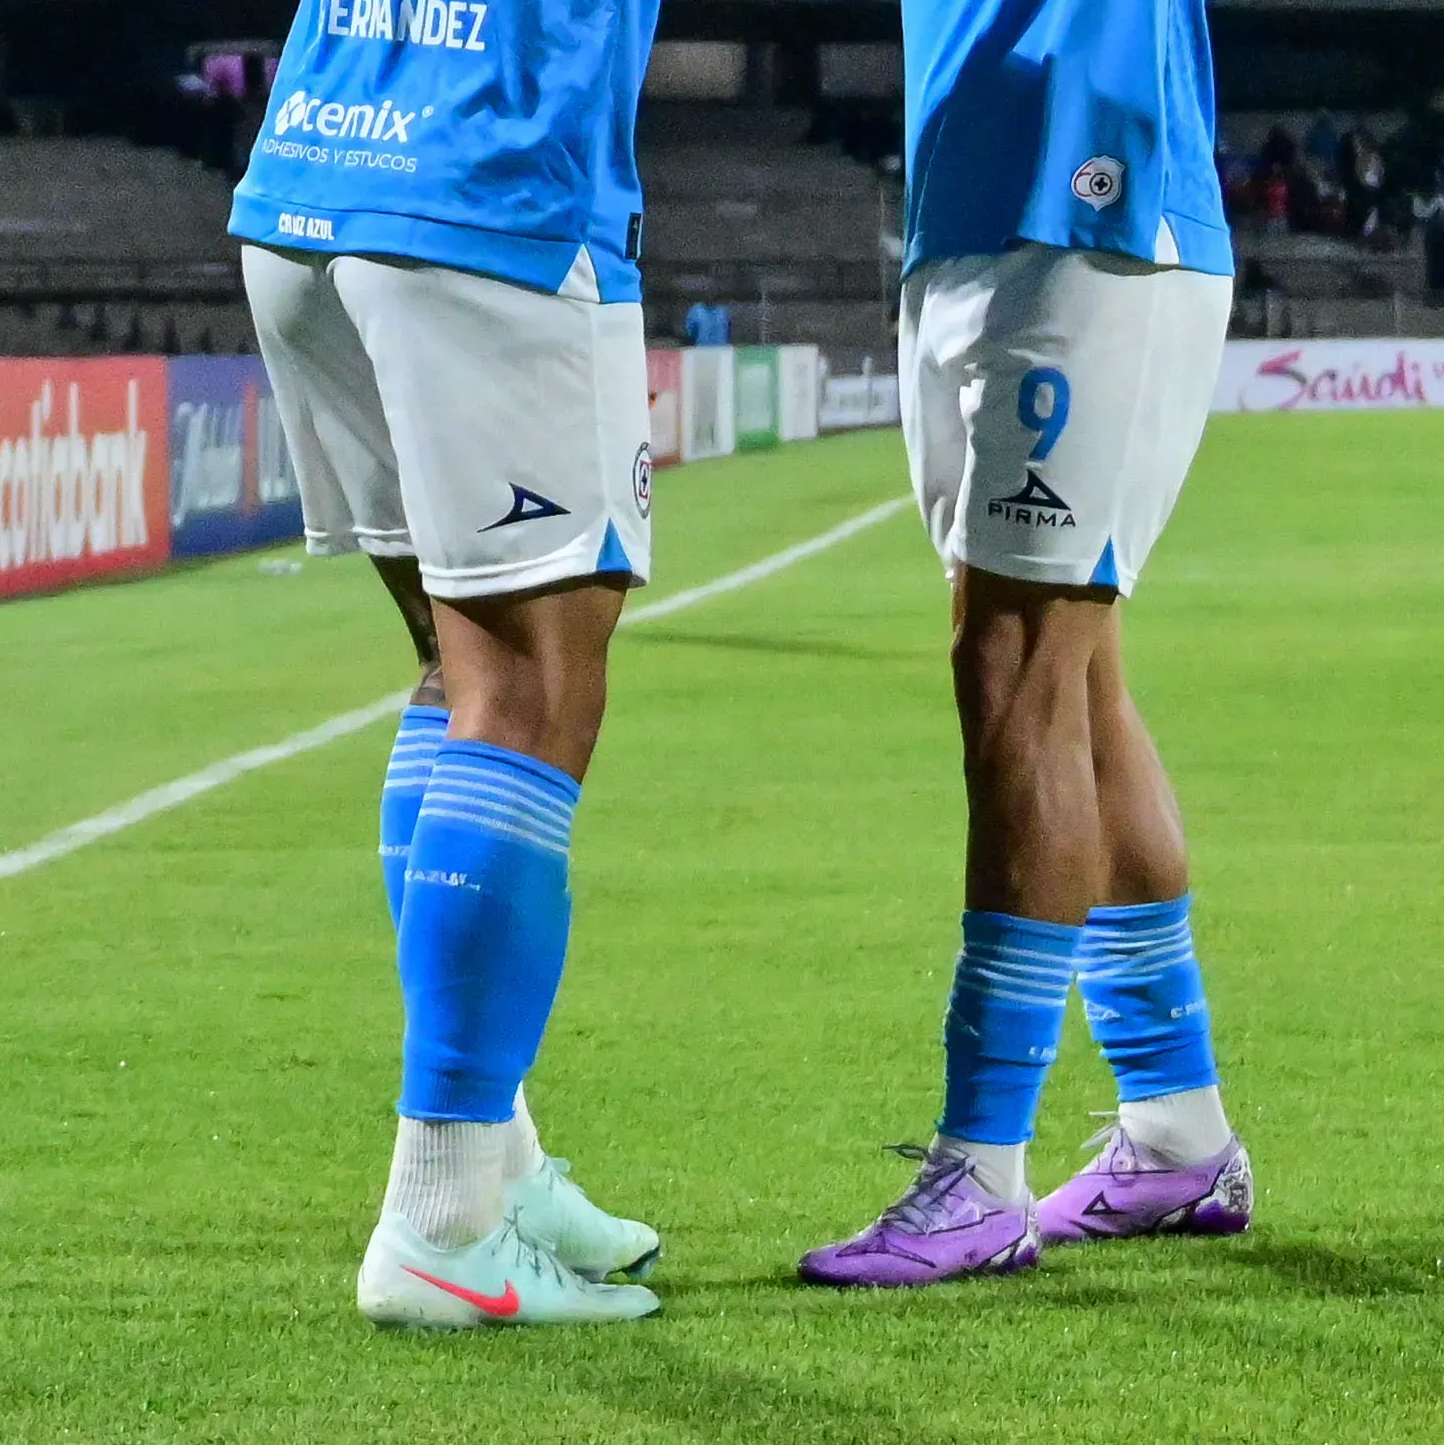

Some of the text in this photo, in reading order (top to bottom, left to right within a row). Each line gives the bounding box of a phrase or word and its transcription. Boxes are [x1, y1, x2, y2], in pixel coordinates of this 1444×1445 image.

[303, 98, 416, 143] cemix
[261, 138, 418, 173] ADHESIVOS Y ESTUCOS
[278, 212, 335, 241] CRUZ AZUL
[1237, 348, 1427, 412] Saudi
[1018, 365, 1071, 462] 9
[987, 500, 1078, 529] PIRMA
